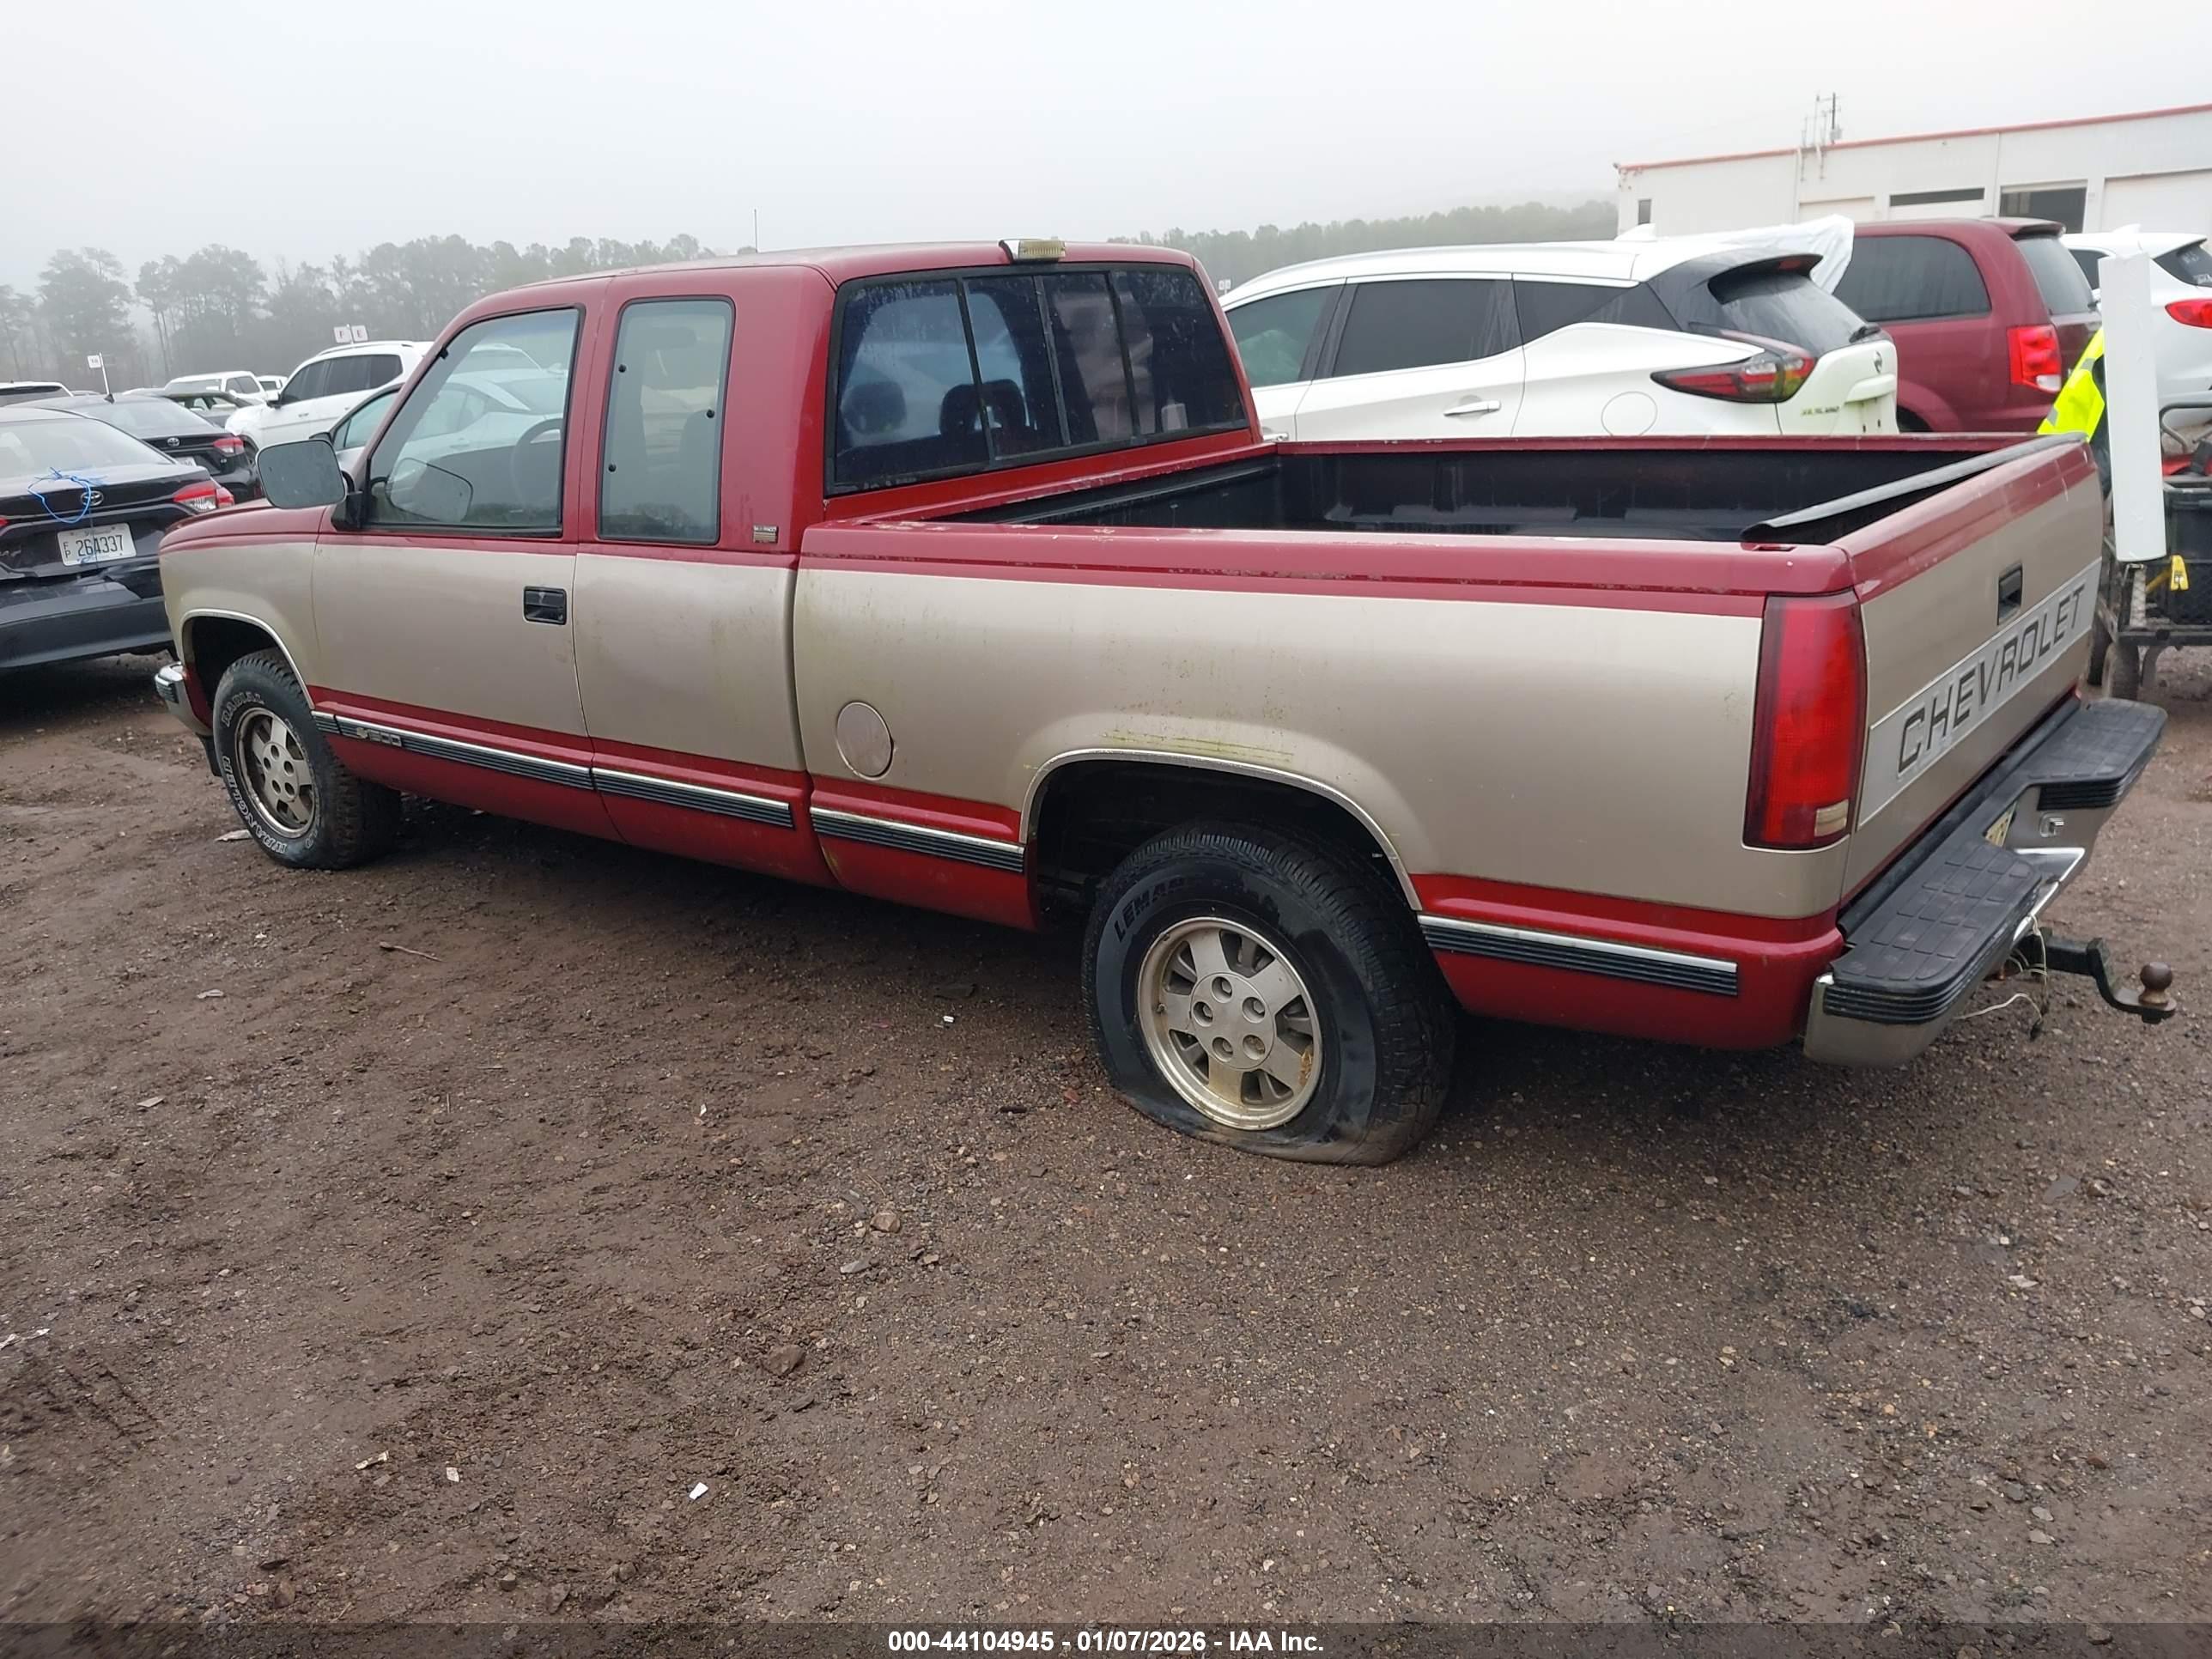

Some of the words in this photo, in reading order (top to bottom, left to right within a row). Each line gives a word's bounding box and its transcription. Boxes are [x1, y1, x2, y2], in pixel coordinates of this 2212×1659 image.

[76, 534, 124, 556] 264337
[221, 691, 265, 728] RADIAL
[1898, 583, 2086, 775] CHEVROLET
[222, 756, 288, 854] WRANGLER
